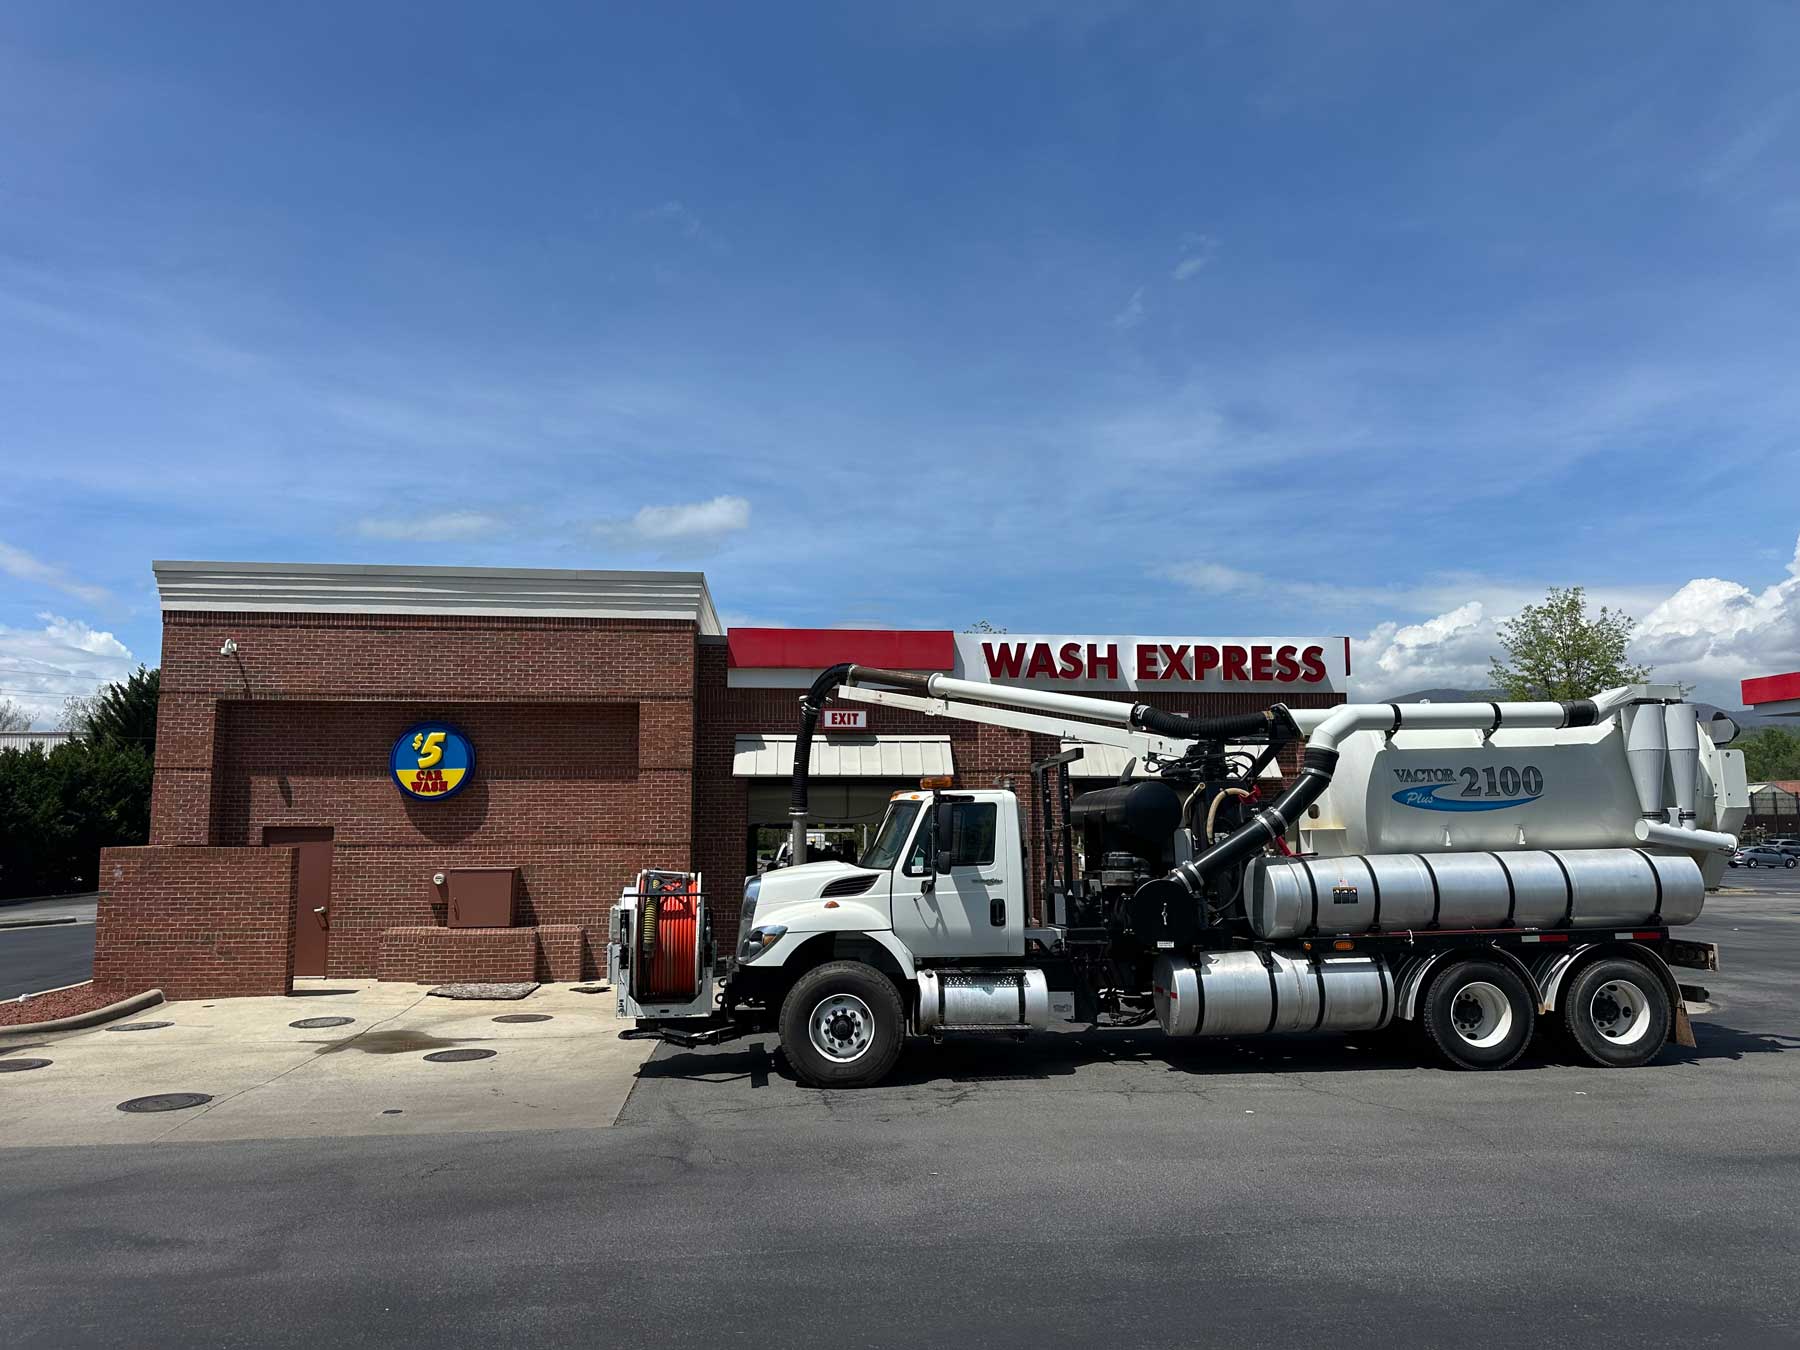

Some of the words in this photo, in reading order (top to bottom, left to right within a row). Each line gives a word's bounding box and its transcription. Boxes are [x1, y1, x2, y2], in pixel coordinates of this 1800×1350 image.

[981, 642, 1118, 680] WASH
[1136, 644, 1327, 683] EXPRESS
[831, 712, 859, 725] EXIT
[412, 732, 446, 769] $5
[416, 769, 443, 782] CAR
[1393, 768, 1457, 783] VACTOR
[1459, 765, 1544, 797] 2100
[411, 781, 449, 793] WASH
[1406, 791, 1434, 804] Plus
